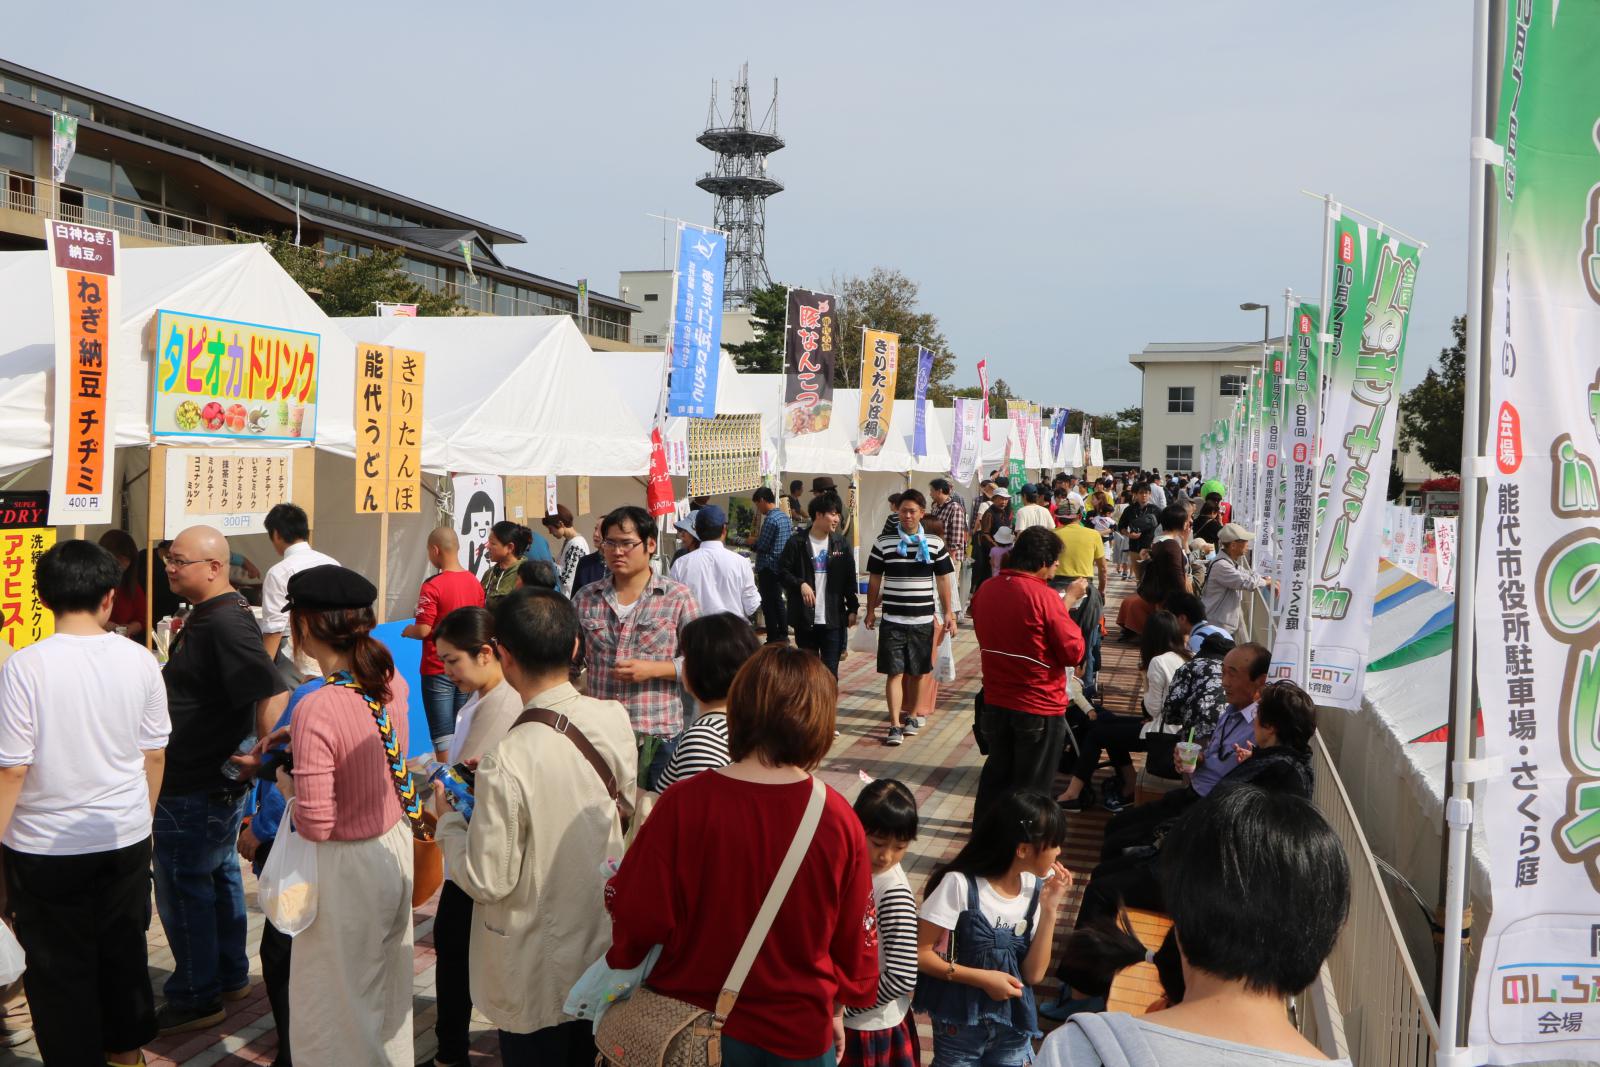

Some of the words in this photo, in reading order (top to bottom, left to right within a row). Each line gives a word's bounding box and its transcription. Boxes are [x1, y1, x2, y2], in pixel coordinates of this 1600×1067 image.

[56, 223, 112, 251] 白神ねぎと
[69, 243, 103, 262] 納豆の
[163, 324, 315, 403] タピオカドリンク
[797, 305, 822, 408] 豚なんこつ
[77, 409, 100, 491] チヂミ
[363, 350, 384, 511] 能代うどん
[395, 355, 417, 511] きりたんぽ
[1501, 411, 1516, 466] 会場
[224, 515, 250, 527] 300円
[1311, 669, 1352, 684] 2017
[1496, 483, 1541, 889] 能代市役所駐車場・さくら庭
[1538, 1011, 1583, 1034] 会場
